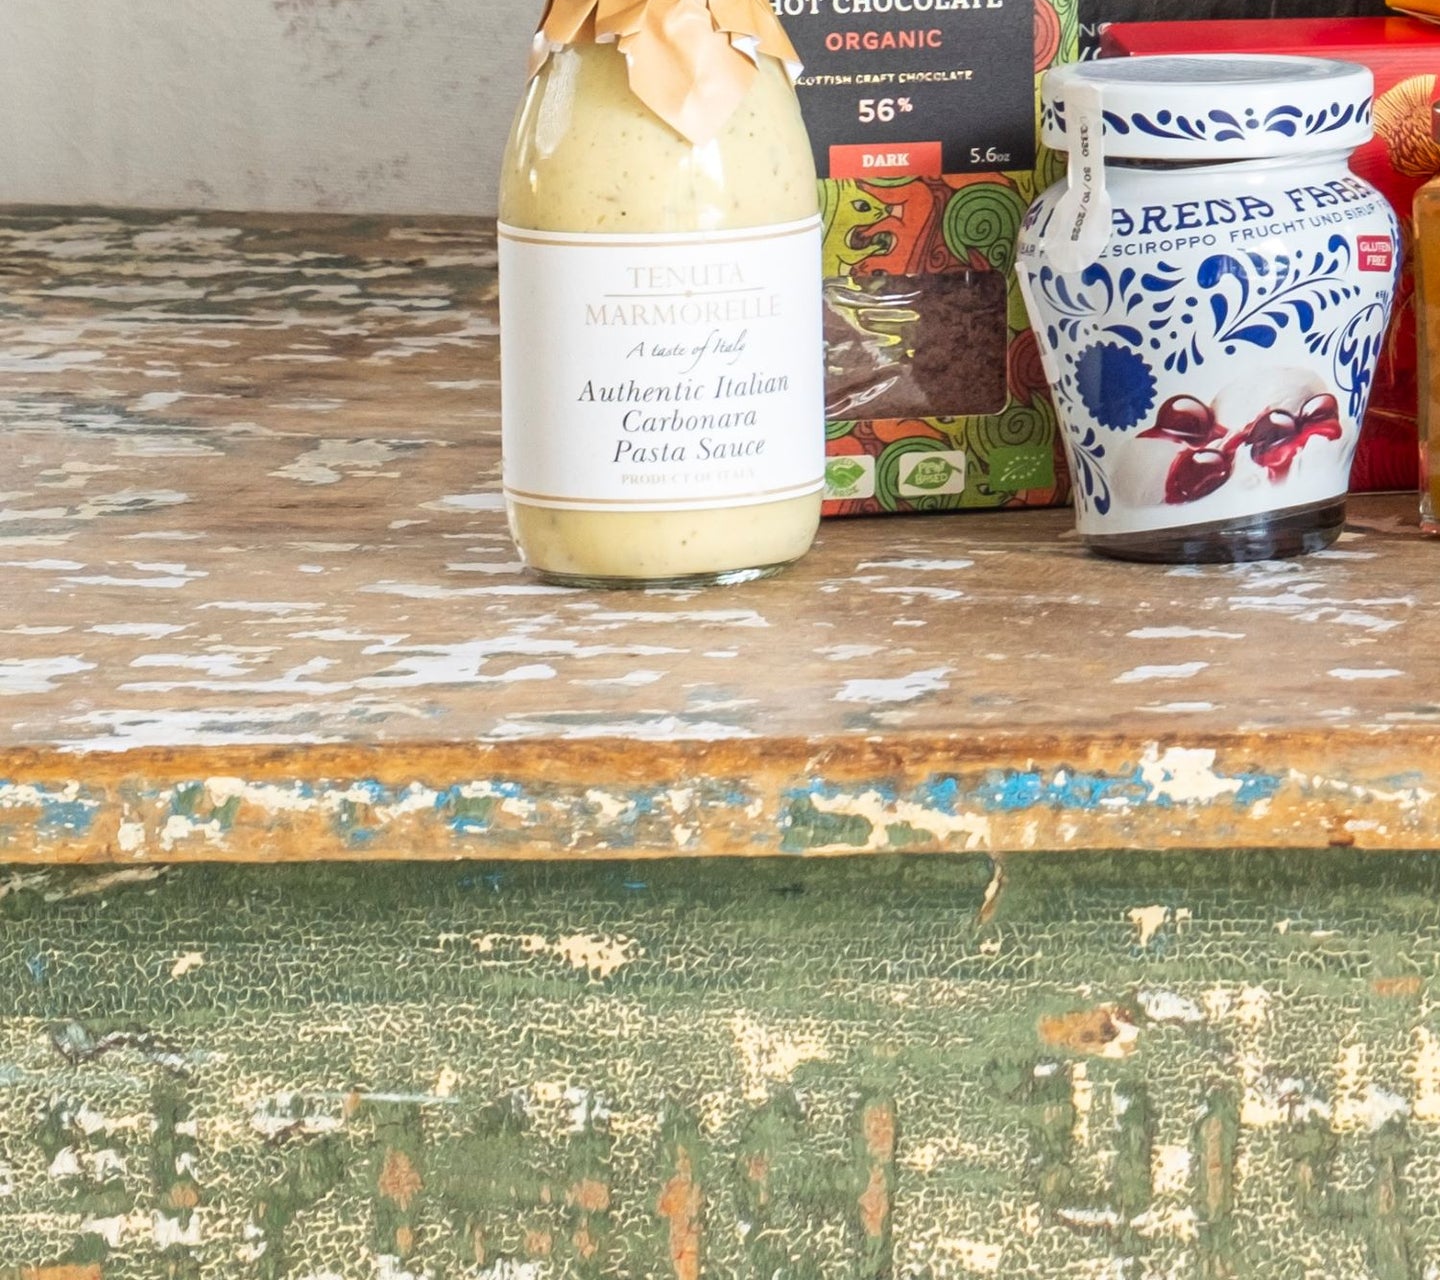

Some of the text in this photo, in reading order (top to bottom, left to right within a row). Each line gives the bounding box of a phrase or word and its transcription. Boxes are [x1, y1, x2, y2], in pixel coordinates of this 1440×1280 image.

[825, 30, 942, 51] ORGANIC
[858, 97, 913, 123] 56%
[862, 153, 910, 168] DARK
[627, 261, 745, 289] TENUTA
[584, 294, 782, 326] MARMORELLE
[651, 344, 686, 357] taste
[577, 372, 789, 403] Authentic Italian
[622, 409, 757, 433] Carbonara
[613, 437, 766, 463] Pasta Sauce
